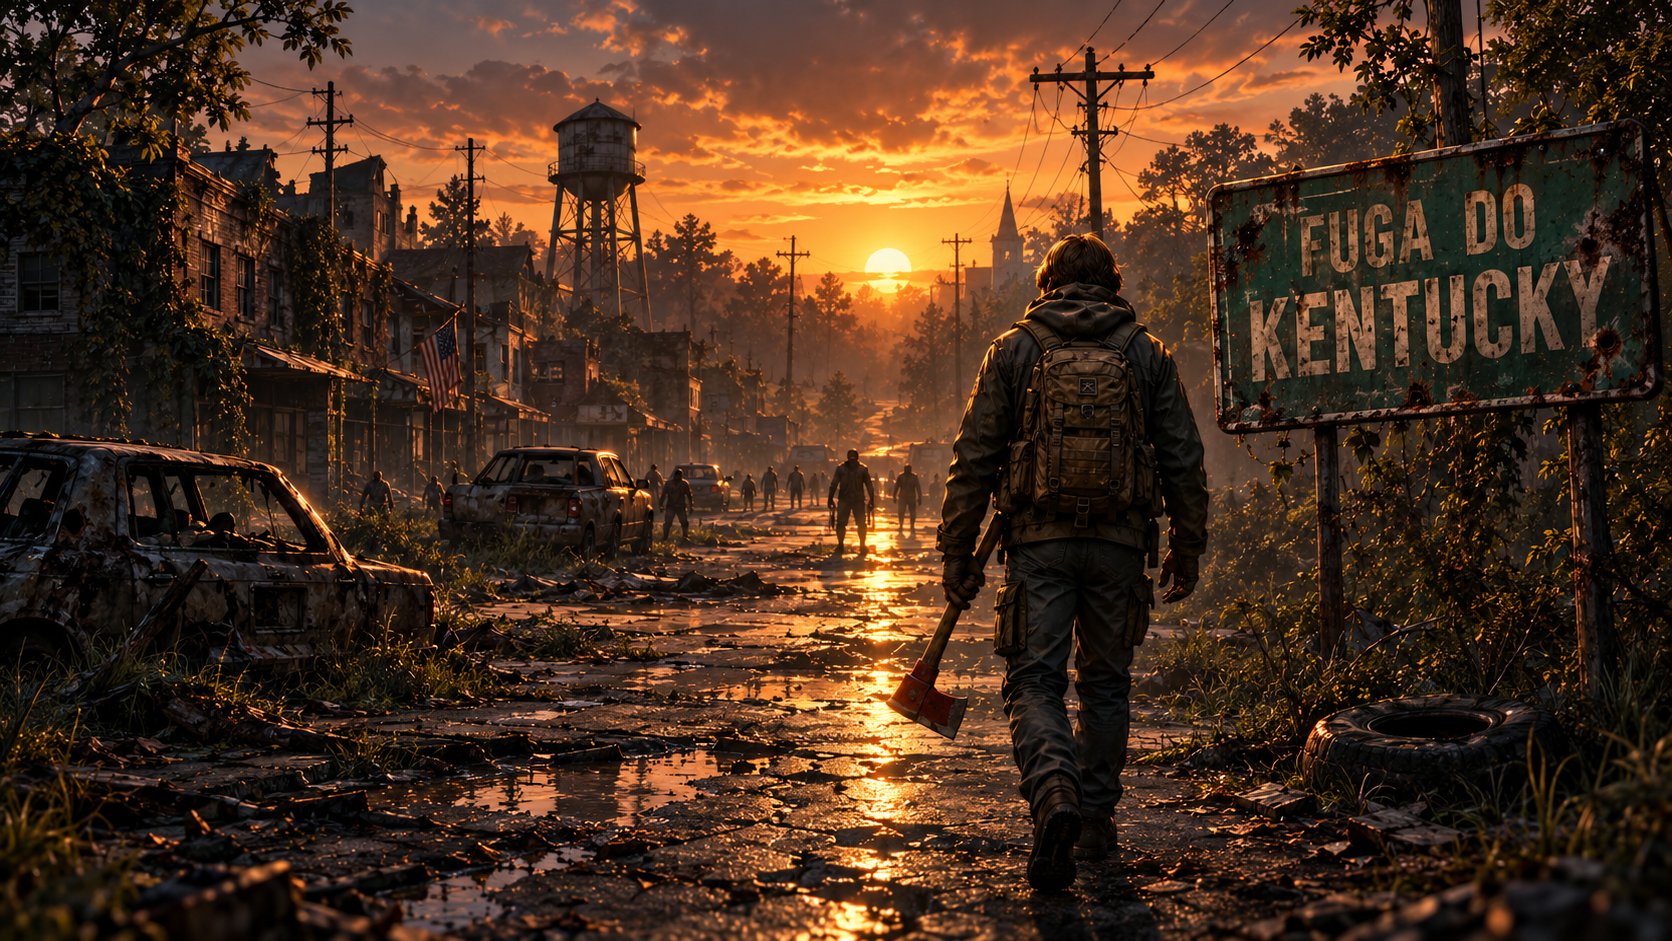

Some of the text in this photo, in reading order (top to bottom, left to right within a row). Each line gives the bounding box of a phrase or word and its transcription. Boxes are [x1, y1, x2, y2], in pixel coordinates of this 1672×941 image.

[1300, 183, 1536, 277] FUGA DO
[1249, 255, 1612, 382] KENTUCKY
